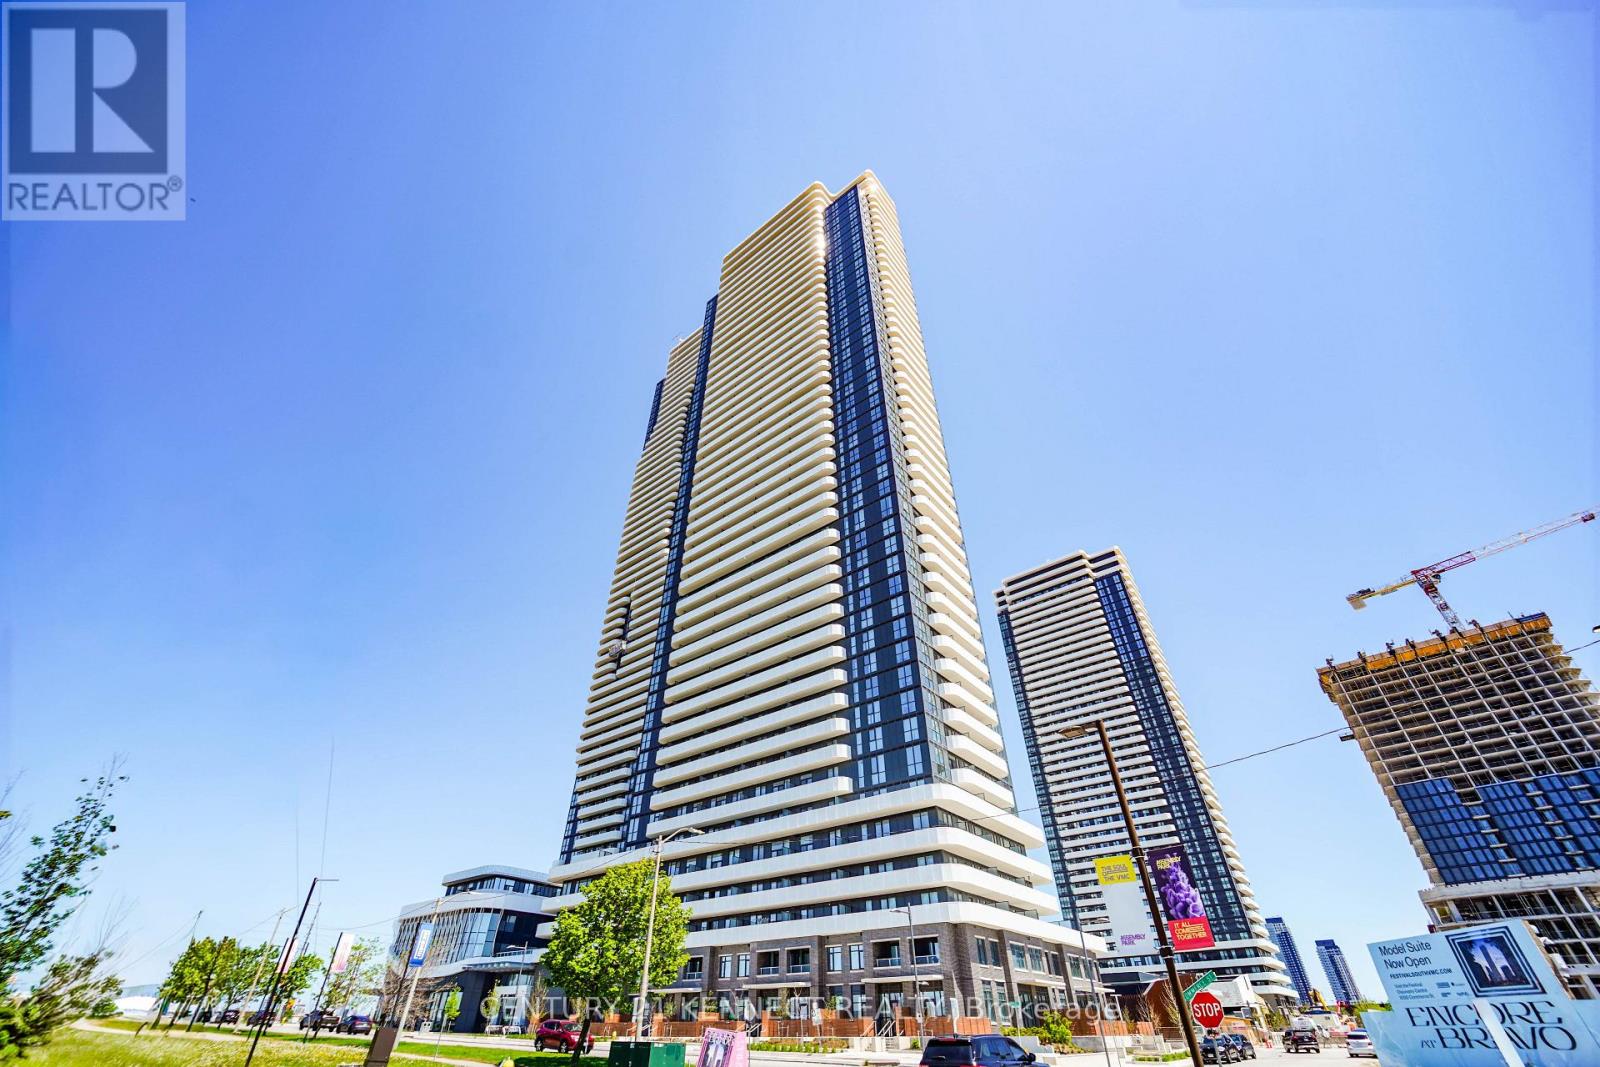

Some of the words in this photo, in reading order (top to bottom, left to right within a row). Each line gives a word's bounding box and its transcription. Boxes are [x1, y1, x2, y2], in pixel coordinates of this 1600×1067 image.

[1176, 932, 1207, 941] TOGETHER
[1378, 943, 1406, 957] Model
[1406, 940, 1432, 953] Suite
[1383, 958, 1404, 970] Now
[1404, 955, 1432, 968] Open
[1193, 1002, 1220, 1018] STOP
